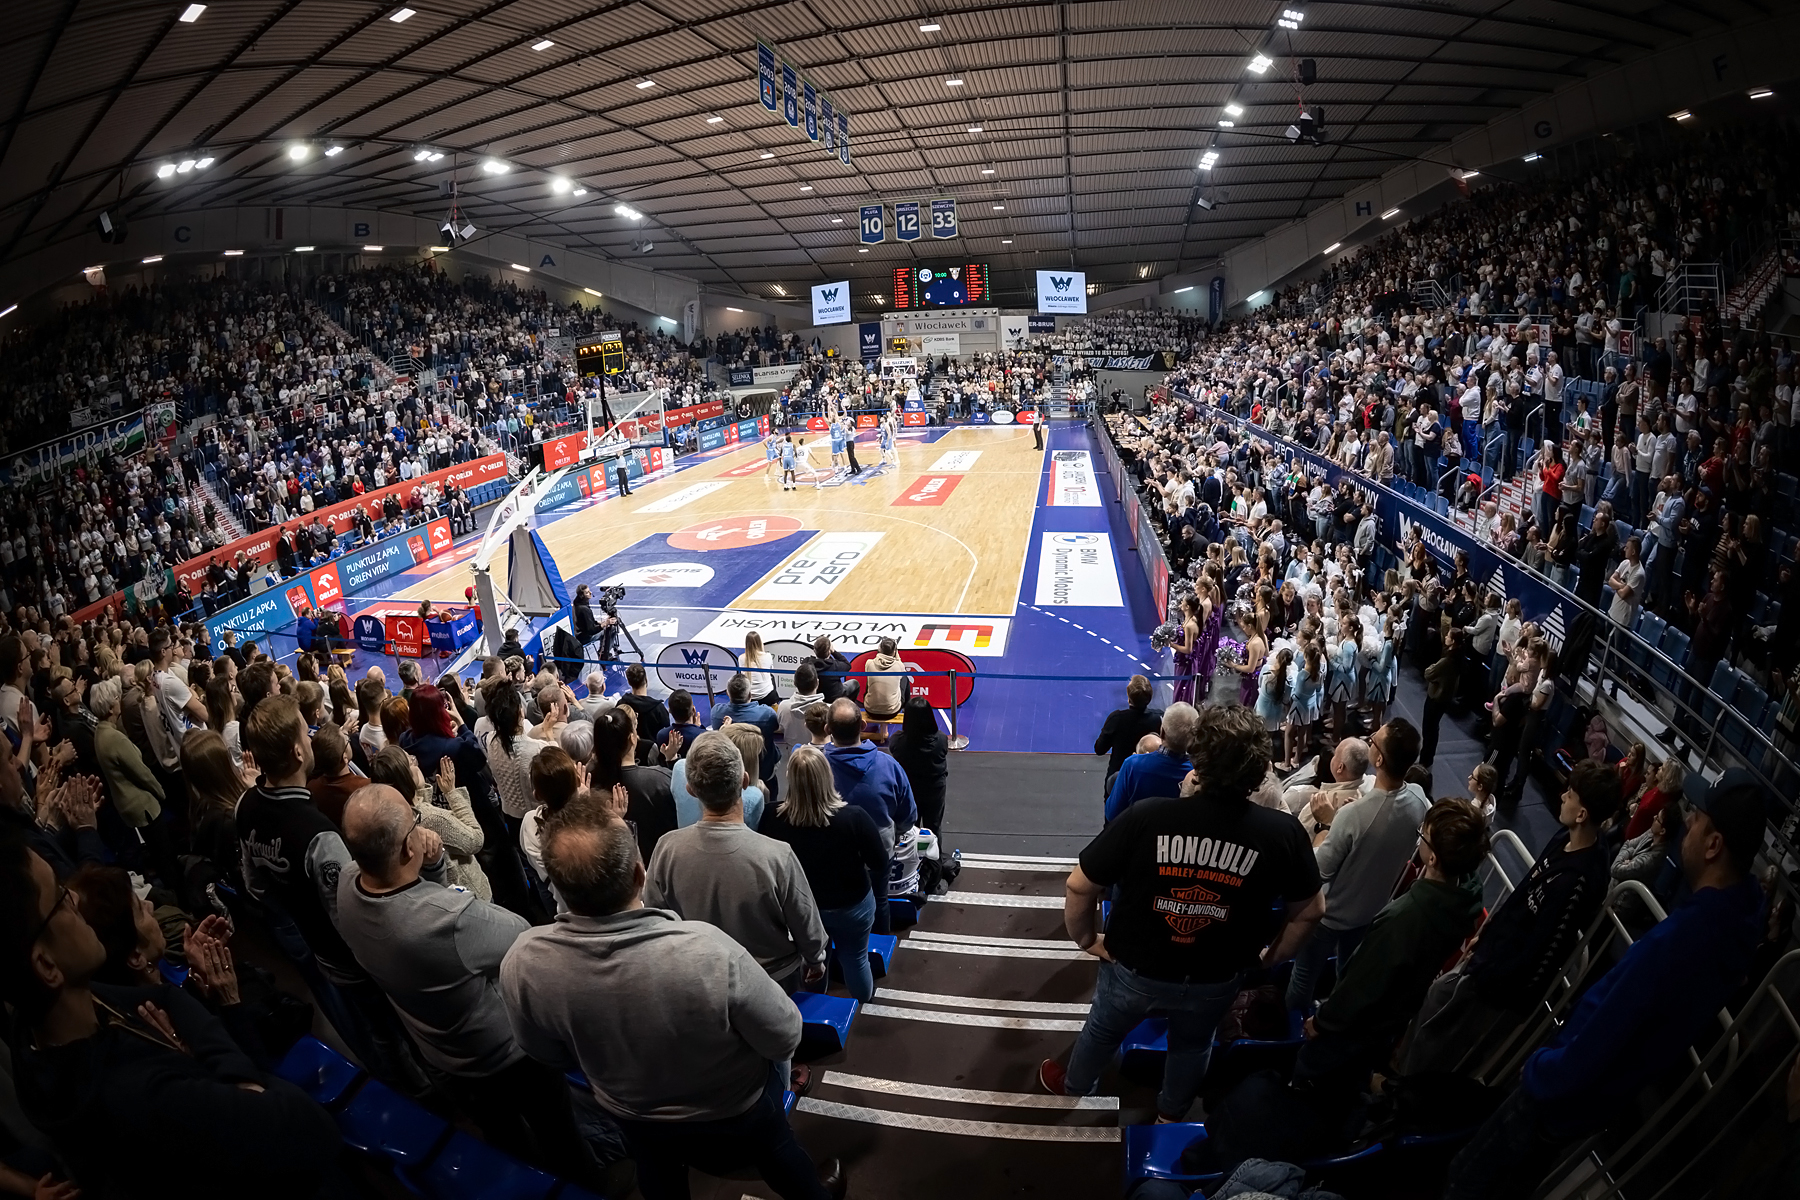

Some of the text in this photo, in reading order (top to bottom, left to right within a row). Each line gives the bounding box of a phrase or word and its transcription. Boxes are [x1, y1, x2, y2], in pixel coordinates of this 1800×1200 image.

[759, 63, 774, 81] 2003
[1712, 54, 1728, 81] F
[1533, 120, 1552, 138] G
[1355, 201, 1373, 216] H
[862, 217, 882, 234] 10
[898, 214, 918, 231] 12
[933, 211, 955, 228] 33
[174, 225, 192, 243] C
[353, 222, 371, 237] B
[538, 254, 557, 268] A
[925, 292, 931, 300] 0
[953, 290, 960, 298] 0
[817, 305, 845, 314] WŁOCŁAWEK
[914, 320, 967, 330] Włocławek
[1274, 441, 1286, 455] pre
[487, 461, 504, 471] ORLEN
[554, 456, 571, 466] ORLEN
[456, 470, 473, 480] ORLEN
[246, 540, 271, 556] ORLEN
[433, 538, 450, 550] ORLEN
[1420, 524, 1461, 560] WŁOCŁAW
[346, 545, 400, 574] PUNKTUJ Z APKĄ
[1080, 548, 1099, 565] BMW
[190, 565, 210, 580] ORLE
[349, 562, 390, 587] ORLEN VITAY
[773, 559, 817, 585] pre
[809, 551, 861, 585] zero
[1052, 548, 1074, 605] Dynamic Motors
[319, 587, 339, 601] ORLEN
[213, 599, 278, 637] PUNKTUJ Z APKĄ
[720, 618, 907, 633] WŁOCŁAWSKI
[457, 621, 474, 637] molten
[404, 645, 417, 654] Pekao
[777, 655, 798, 664] KDBS
[909, 687, 929, 696] LEN
[245, 828, 281, 861] Anwil
[1156, 834, 1259, 877] HONOLULU
[1159, 865, 1243, 888] HARLEY-DAVIDSON
[1176, 890, 1214, 901] MOTOR
[1156, 899, 1228, 919] HARLEY-DAVIDSON
[1170, 915, 1206, 932] CYCLES
